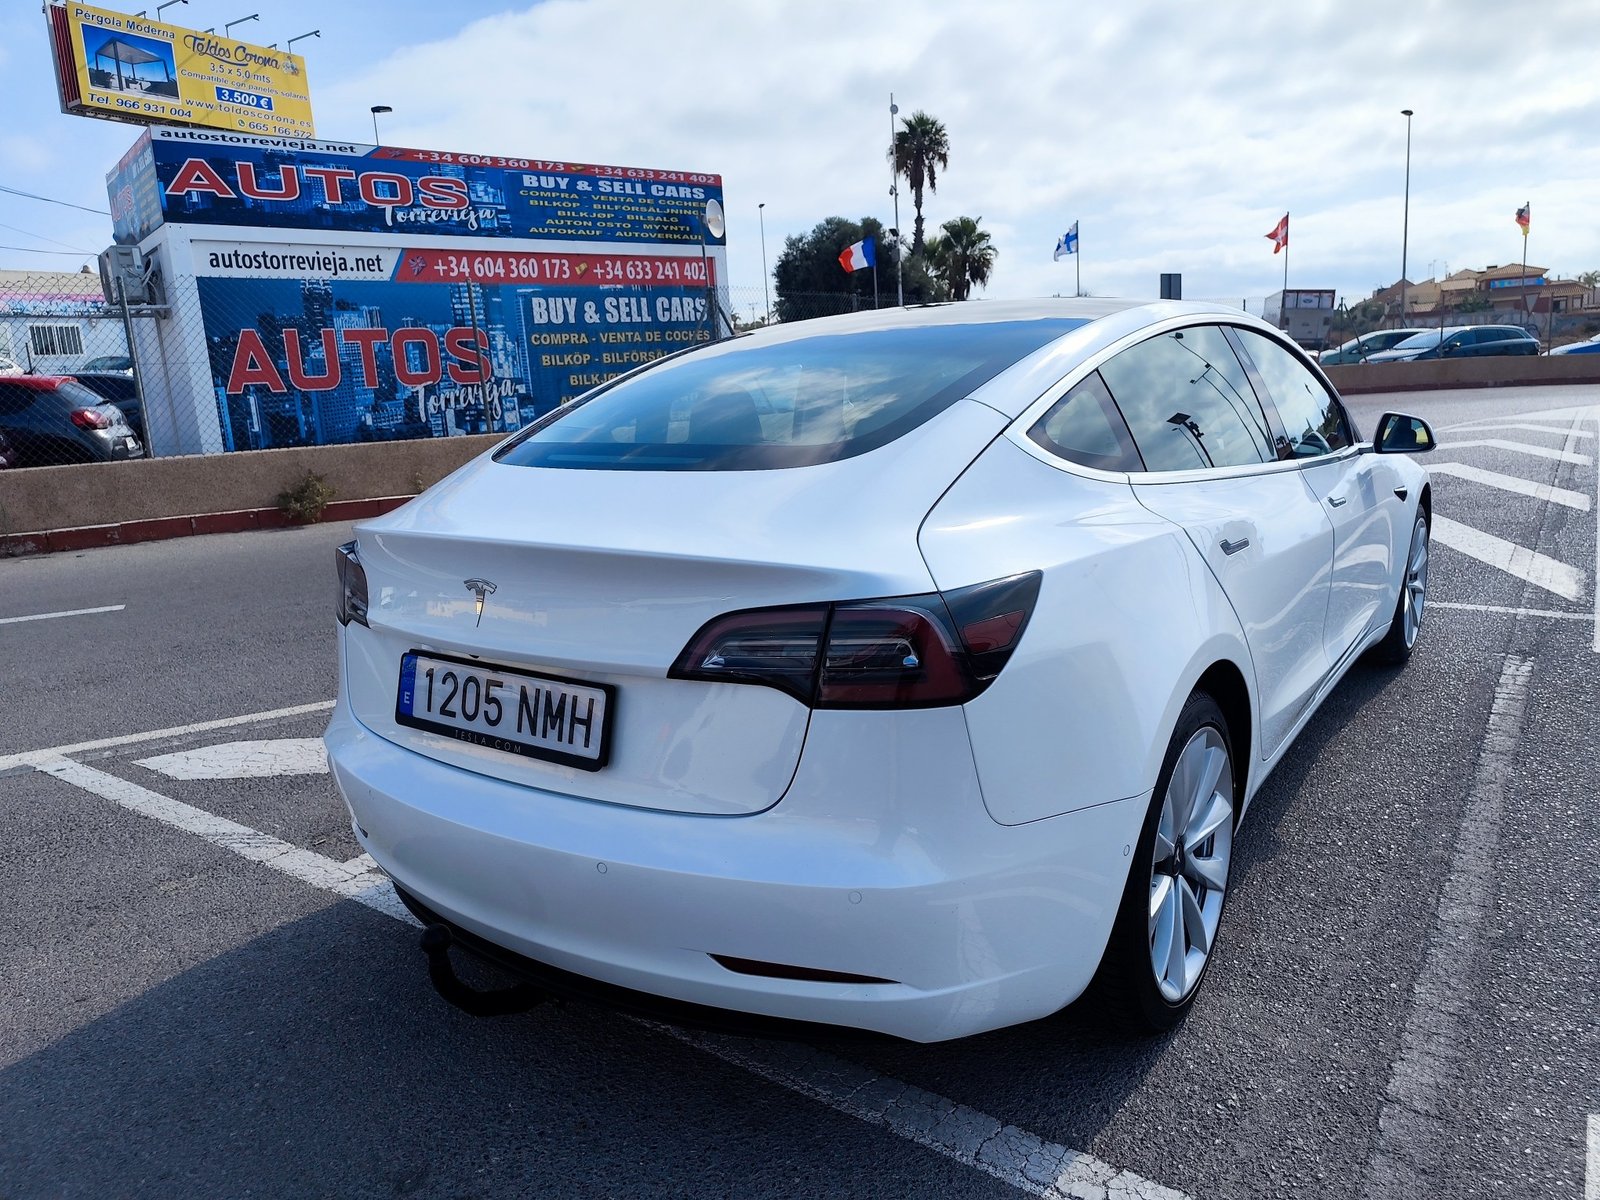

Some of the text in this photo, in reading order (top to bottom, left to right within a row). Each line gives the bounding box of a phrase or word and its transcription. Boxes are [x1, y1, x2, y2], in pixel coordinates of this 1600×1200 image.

[75, 8, 175, 39] Pérgola Moderna
[183, 34, 280, 70] Toldos Corona
[210, 62, 224, 73] 3,5
[236, 68, 251, 79] 5,0
[180, 69, 308, 101] Compatible con paneles solares
[87, 93, 192, 118] Tel. 966 931 004
[221, 89, 269, 108] 3.500 €
[185, 99, 311, 128] www.toldoscorona.es
[160, 130, 357, 153] autostorrevieja.net
[248, 121, 312, 139] 665 166 572
[413, 151, 715, 185] +34 604 360 173 +34 633 241 402
[165, 157, 470, 210] AUTOS
[522, 174, 705, 200] BUY & SELL CARS
[519, 190, 579, 199] COMPRA
[590, 194, 634, 203] VENTA
[638, 197, 655, 205] DE
[658, 199, 706, 208] COCHES
[378, 204, 495, 231] Torrevieja
[546, 219, 592, 227] AUTON
[596, 221, 631, 229] OSTO
[643, 223, 690, 231] MYYNTI
[626, 214, 679, 223] BILSALG
[529, 227, 603, 236] AUTOKAUF
[209, 249, 384, 276] autostorrevieja.net
[433, 255, 706, 280] +34 604 360 173 +34 633 241 402
[531, 296, 708, 324] BUY & SELL CARS
[531, 333, 589, 345] COMPRA
[600, 332, 642, 343] VENTA
[645, 331, 662, 342] DE
[227, 327, 491, 394] AUTOS
[542, 351, 591, 366] BILKÖP
[411, 377, 516, 423] Torrevieja
[403, 691, 411, 704] E
[425, 667, 595, 748] 1205 NMH
[455, 729, 521, 754] TESLA.COM
